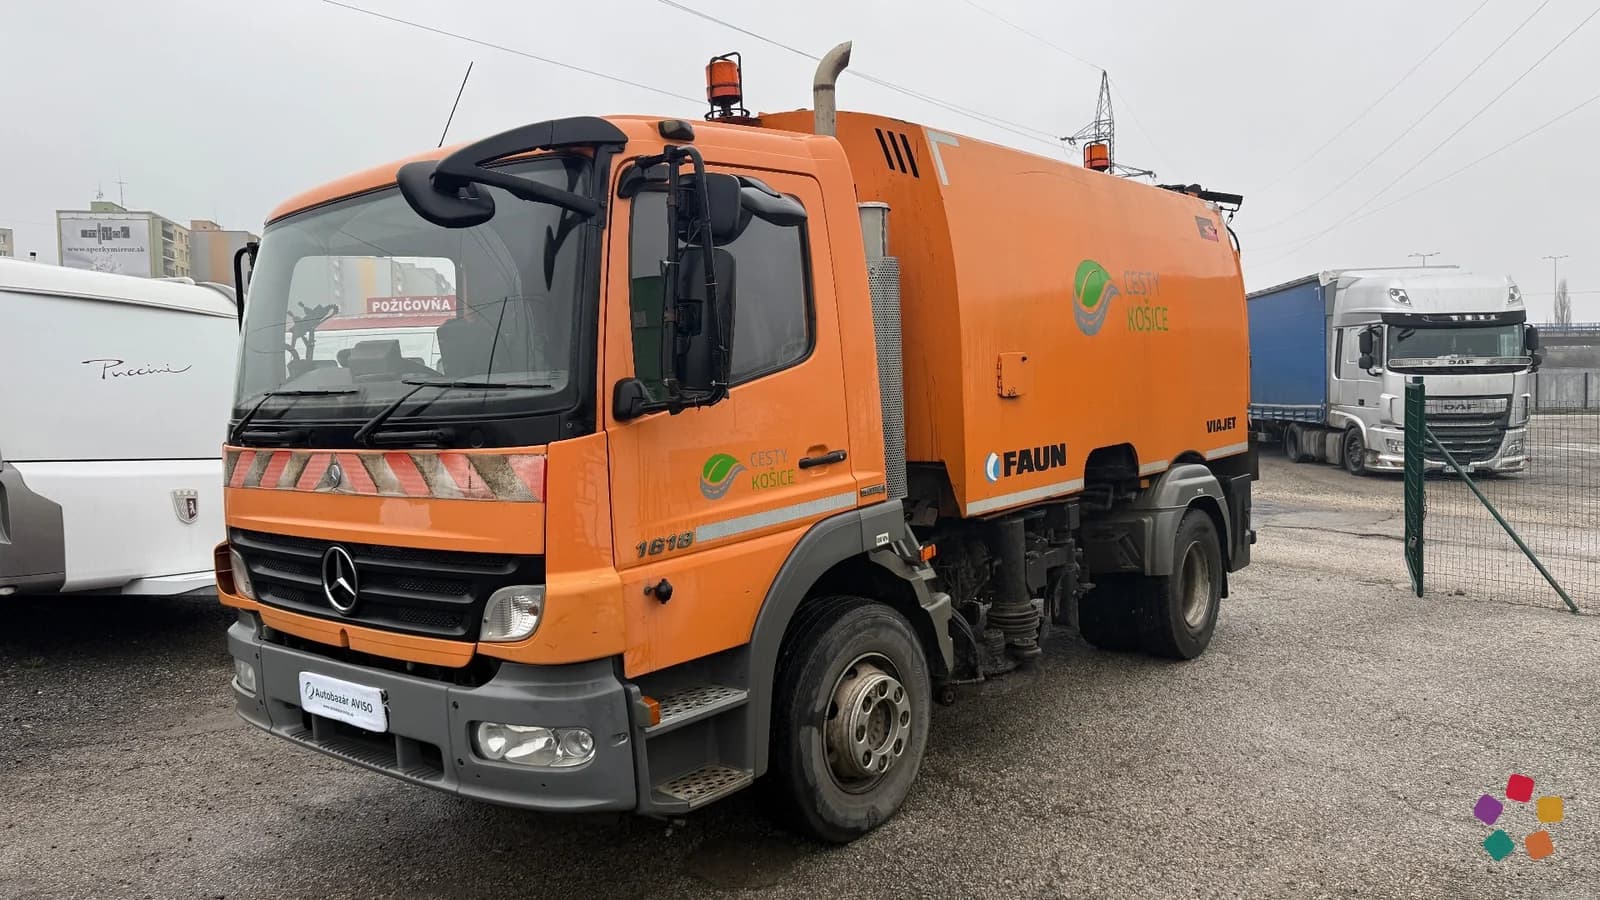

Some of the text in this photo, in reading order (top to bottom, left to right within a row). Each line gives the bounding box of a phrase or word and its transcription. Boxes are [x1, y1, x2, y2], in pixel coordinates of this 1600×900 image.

[1123, 270, 1161, 297] CESTY
[371, 297, 452, 313] POŽIČOVŇA
[1127, 297, 1169, 331] KOŠICE
[82, 358, 192, 380] Puccini
[1442, 402, 1478, 411] DAF
[1206, 416, 1237, 433] VIAJET
[750, 449, 788, 468] CESTY
[1003, 442, 1067, 477] FAUN
[751, 466, 795, 490] KOŠICE
[635, 530, 694, 558] 1618
[315, 687, 349, 706] Autobazár
[351, 698, 373, 713] AVISO
